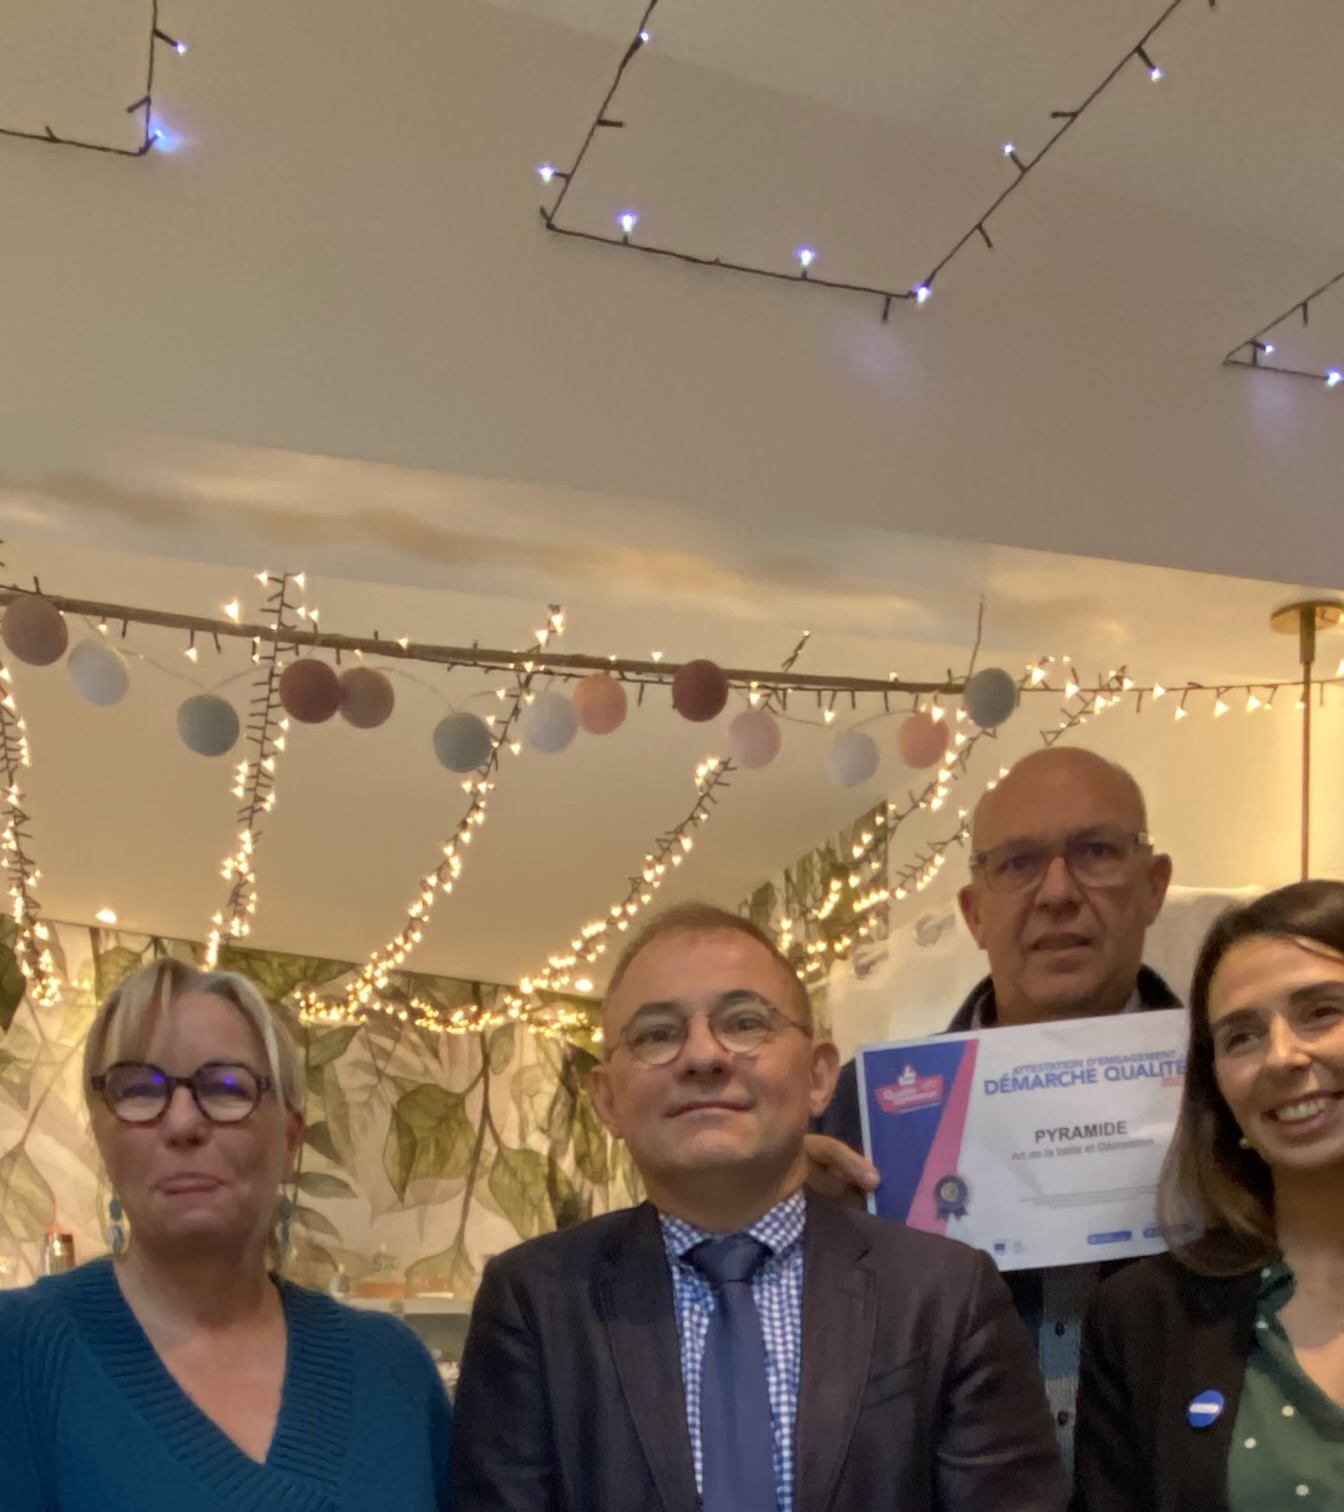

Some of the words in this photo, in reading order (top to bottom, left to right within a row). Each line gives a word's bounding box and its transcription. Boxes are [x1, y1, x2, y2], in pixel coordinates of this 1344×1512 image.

[984, 1068, 1099, 1096] DÉMARCHE
[1104, 1054, 1187, 1082] QUALITÉ
[1012, 1059, 1084, 1076] ATTESTATION
[1034, 1120, 1128, 1144] PYRAMIDE
